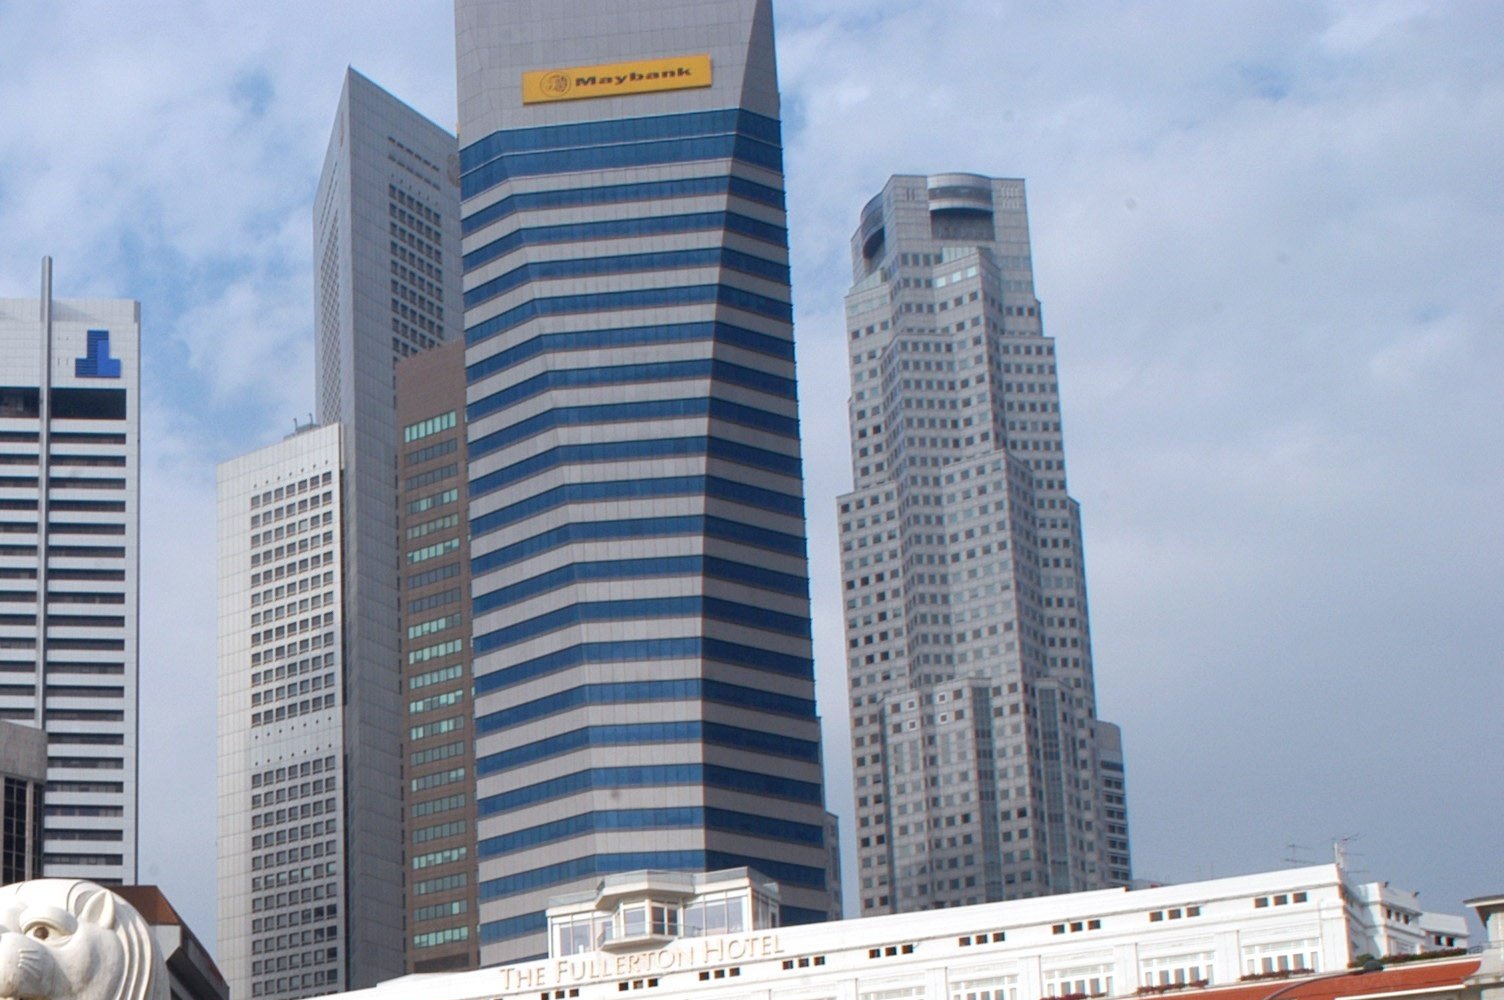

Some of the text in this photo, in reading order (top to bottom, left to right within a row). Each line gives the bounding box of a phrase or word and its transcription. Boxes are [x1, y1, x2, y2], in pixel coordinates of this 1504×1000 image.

[575, 67, 692, 87] Maybank
[500, 935, 785, 990] THE FULLERTON HOTEL
